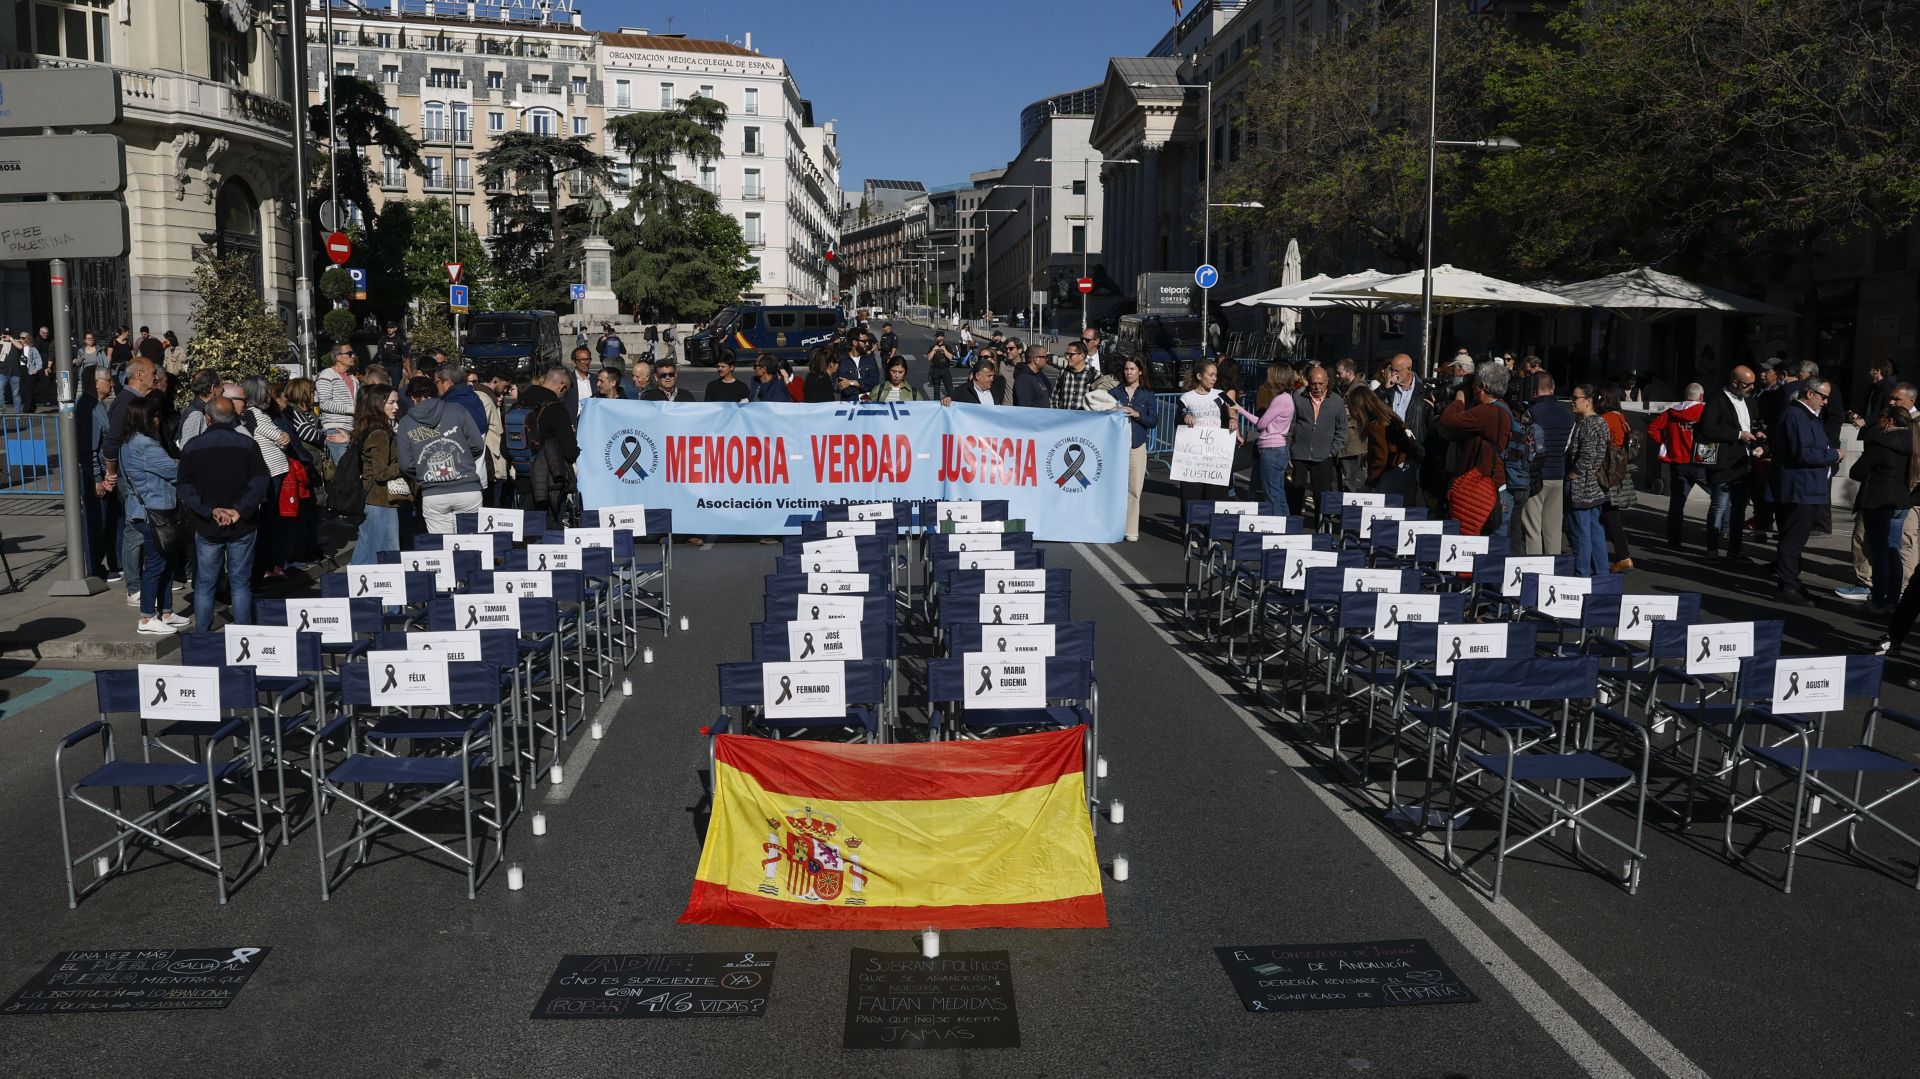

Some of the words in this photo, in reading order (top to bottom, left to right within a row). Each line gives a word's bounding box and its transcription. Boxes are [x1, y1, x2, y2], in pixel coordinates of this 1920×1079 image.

[609, 52, 665, 62] ORGANIZACIÓN
[668, 56, 696, 65] MÉDICA
[698, 58, 735, 67] COLEGIAL
[748, 60, 775, 70] ESPAÑA
[2, 226, 41, 243] FREE
[1160, 286, 1190, 296] telpark
[801, 332, 835, 346] POLIC
[1200, 428, 1215, 445] 46
[666, 435, 789, 484] MEMORIA
[811, 434, 912, 484] VERDAD
[938, 434, 1038, 487] JUSTICIA
[1183, 468, 1224, 480] JUSTICIA
[697, 498, 772, 509] Asociación
[776, 497, 835, 509] Víctimas
[520, 581, 538, 589] VÍCTOR
[1008, 580, 1035, 588] FRANCISCO
[484, 605, 507, 613] TAMARA
[479, 614, 510, 623] MARGARITA
[1009, 613, 1029, 621] JOSEFA
[1407, 613, 1422, 621] ROCÍO
[825, 630, 840, 640] JOSÉ
[262, 646, 276, 655] JOSÉ
[824, 641, 843, 650] MARÍA
[1470, 645, 1490, 653] RAFAEL
[1719, 644, 1737, 652] PABLO
[1004, 666, 1026, 675] MARIA
[409, 673, 426, 682] FÉLIX
[1000, 678, 1027, 687] EUGENIA
[1806, 678, 1830, 689] AGUSTÍN
[180, 689, 196, 698] PEPE
[796, 685, 830, 694] FERNANDO
[72, 952, 99, 960] UNA
[137, 949, 168, 959] MÁS
[1233, 951, 1255, 961] EL
[1271, 950, 1349, 961] CONSEJERO
[60, 963, 79, 971] EL
[174, 962, 216, 970] SALVA
[866, 957, 934, 973] SOBRAN
[942, 959, 1009, 972] POLÍTICOS
[1308, 962, 1328, 972] DE
[1339, 959, 1411, 970] ANDALUCÍA
[627, 976, 716, 985] SUFICIENTE
[730, 974, 753, 986] YA
[859, 974, 887, 983] QUE
[1258, 976, 1320, 988] DEBERÍA
[1324, 977, 1380, 985] REVISARSE
[859, 984, 877, 992] DE
[889, 984, 942, 992] NUESTRA
[950, 984, 992, 992] CAUSA
[1265, 991, 1346, 1001] SIGNIFICADO
[1387, 985, 1461, 1001] EMPATÍA
[553, 1000, 622, 1013] ROBAR
[635, 992, 693, 1013] 46
[700, 999, 765, 1012] VIDAS?
[858, 996, 921, 1012] FALTAN
[932, 996, 1008, 1011] MEDIDAS
[856, 1015, 883, 1024] PARA
[888, 1015, 913, 1024] QUE
[881, 1026, 975, 1042] JAMÁS
